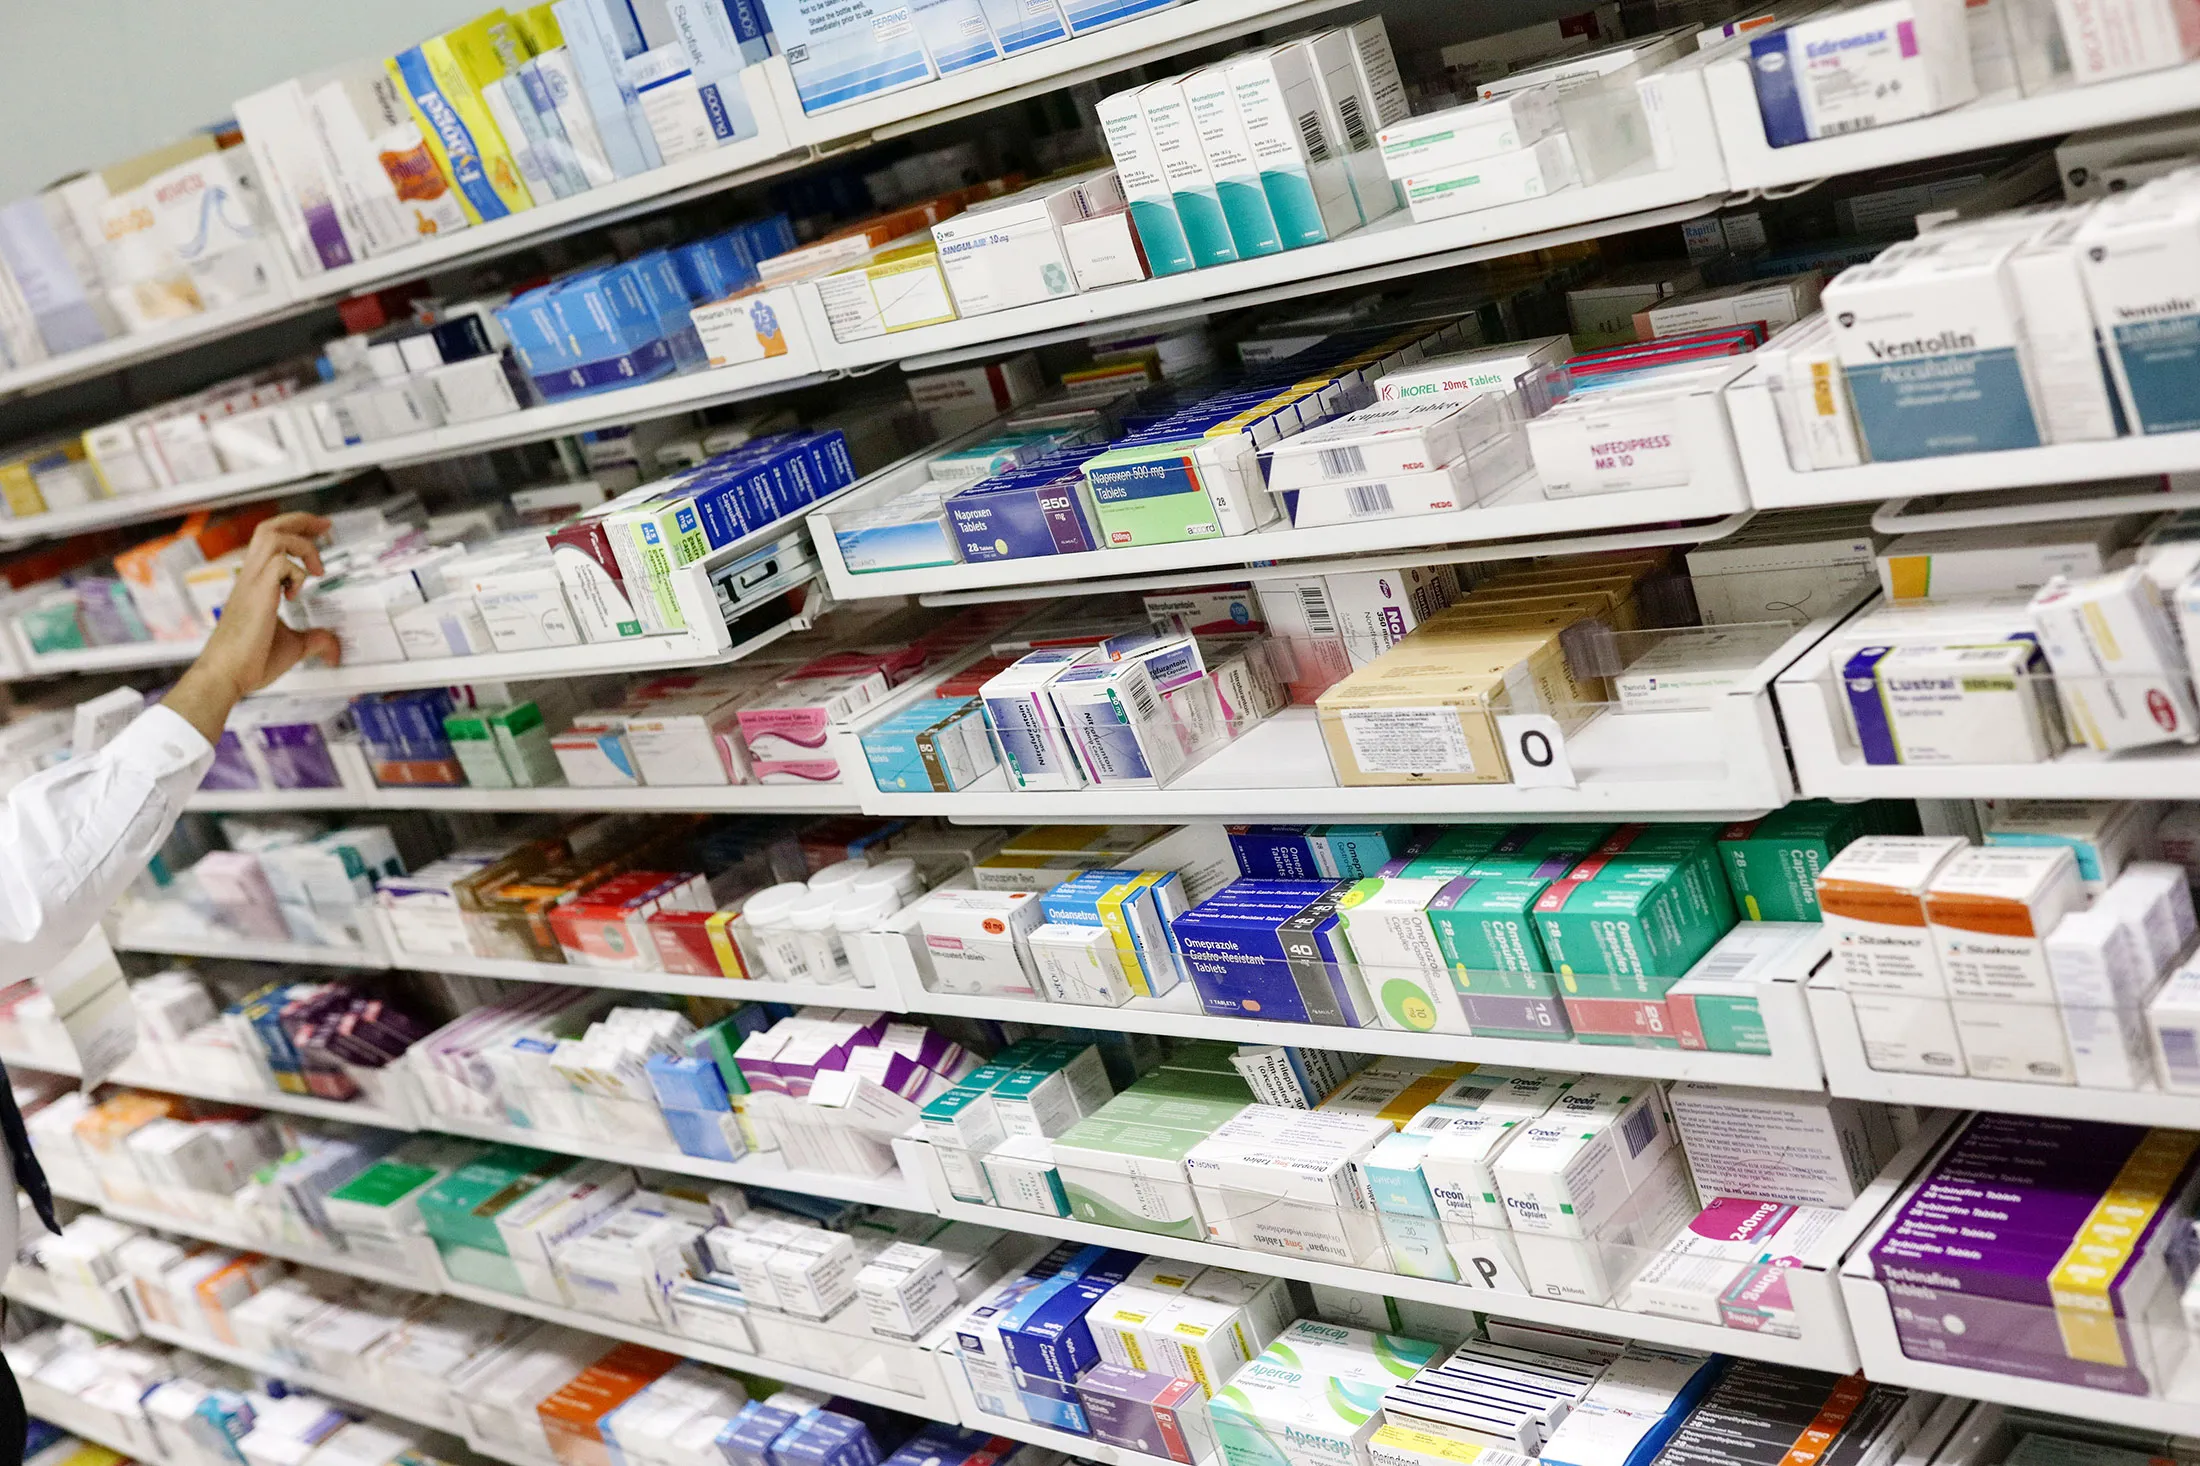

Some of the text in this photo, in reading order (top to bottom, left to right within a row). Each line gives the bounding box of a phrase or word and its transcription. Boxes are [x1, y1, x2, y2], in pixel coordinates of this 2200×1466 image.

[809, 16, 828, 27] Shake
[828, 14, 837, 23] the
[837, 9, 853, 20] bottle
[809, 23, 841, 38] immediately
[841, 17, 855, 28] prior
[863, 9, 874, 19] use
[872, 9, 909, 29] FERRING
[960, 17, 983, 30] FERRING
[674, 4, 705, 66] Salofalk
[1235, 77, 1270, 92] Mometasone
[1191, 90, 1225, 104] Mometasone
[1238, 89, 1258, 100] Furoate
[702, 86, 728, 138] 500mg
[1148, 102, 1180, 115] Mometasone
[1194, 101, 1214, 112] Furoate
[1105, 113, 1137, 126] Mometasone
[1150, 113, 1170, 124] Furoate
[1108, 124, 1127, 134] Furoate
[1685, 223, 1717, 238] Rapitil
[941, 234, 1010, 256] SINGULAIR 10 mg
[725, 306, 734, 315] 75
[753, 309, 771, 324] 75
[1866, 329, 1977, 359] Ventolin
[1400, 374, 1502, 398] iKOREL 20mg Tablets
[1590, 435, 1672, 456] NIFEDIPRESS
[828, 441, 845, 475] Capsules
[1595, 454, 1635, 471] MR 10
[789, 459, 805, 493] Capsules
[1091, 465, 1166, 486] Naproxen 500 mg
[752, 476, 770, 511] Capsules
[1096, 487, 1128, 501] Tablets
[1217, 497, 1227, 506] 28
[721, 493, 738, 528] Capsules
[1040, 496, 1070, 510] 250
[1430, 501, 1453, 509] MEDA
[685, 509, 694, 525] 15
[954, 508, 993, 523] Naproxen
[1054, 512, 1067, 522] mg
[958, 520, 988, 534] Tablets
[1187, 523, 1216, 535] accord
[1112, 531, 1132, 543] 500mg
[1148, 601, 1197, 611] Nitrofurantoin
[1166, 664, 1189, 676] Capsules
[1233, 669, 1250, 716] Nitrofurantoin
[1887, 677, 1955, 692] Lustral
[1017, 704, 1046, 766] Nitrofurantoin
[1084, 712, 1115, 773] Nitrofurantoin
[1520, 729, 1554, 767] O
[1270, 846, 1286, 877] Tablets
[1732, 849, 1747, 868] 28
[1805, 848, 1819, 882] Ome
[1789, 849, 1816, 905] Capsules
[1049, 908, 1098, 921] Ondansetron
[1106, 911, 1118, 921] 4
[1293, 917, 1316, 925] 40
[984, 921, 1003, 931] 20 mg
[1391, 916, 1412, 953] Capsules
[1440, 919, 1455, 937] 28
[1546, 920, 1562, 939] 28
[1184, 937, 1239, 951] Omeprazole
[1289, 944, 1313, 956] 40
[1411, 916, 1441, 979] Omeprazole
[1491, 921, 1517, 972] Capsules
[1602, 920, 1628, 975] Capsules
[1189, 950, 1265, 966] Gastro-Resistant
[1505, 921, 1537, 990] Omeprazole
[1616, 920, 1648, 992] Omeprazole
[1193, 962, 1227, 974] Tablets
[1415, 1007, 1428, 1019] 10
[1534, 1003, 1553, 1027] 10
[1644, 1005, 1664, 1033] 20
[1264, 1055, 1291, 1104] Film-coated
[1510, 1077, 1542, 1088] Creon
[1513, 1083, 1541, 1091] Capsules
[1562, 1095, 1596, 1106] Creon
[1566, 1102, 1596, 1110] Capsules
[1453, 1118, 1484, 1128] Creon
[1527, 1127, 1561, 1138] Creon
[1531, 1134, 1560, 1143] Capsules
[1196, 1160, 1221, 1170] SANOFI
[1243, 1156, 1328, 1173] Ditropan 5mg Tablets
[1434, 1187, 1464, 1201] Creon
[1929, 1183, 2022, 1203] Terbinafine Tablets
[1446, 1198, 1472, 1209] Capsules
[1507, 1197, 1540, 1212] Creon
[1914, 1200, 2009, 1221] Terbinafine Tablets
[1520, 1208, 1548, 1220] Capsules
[1729, 1202, 1779, 1241] 240mg
[1903, 1219, 1997, 1241] Terbinafine Tablets
[1253, 1234, 1347, 1257] Ditropan 5mg Tablets
[1887, 1237, 1983, 1260] Terbinafine Tablets
[1471, 1256, 1498, 1289] P
[1741, 1258, 1793, 1302] 500mg
[1881, 1264, 1962, 1289] Terbinafine
[1561, 1286, 1586, 1295] Abbott
[1886, 1279, 1938, 1300] Tablets
[1295, 1321, 1350, 1339] Apercap
[1065, 1337, 1076, 1355] 100
[1039, 1342, 1055, 1372] Caplets
[1047, 1344, 1068, 1394] Paracetamol
[1249, 1363, 1302, 1384] Apercap
[1236, 1379, 1266, 1389] Peppermint
[1156, 1411, 1172, 1422] 20
[1698, 1409, 1772, 1428] Phenoxymethylpenicillin
[1284, 1425, 1351, 1458] Apercap
[1673, 1440, 1688, 1448] 28
[1682, 1428, 1756, 1449] Phenoxymethylpenicillin
